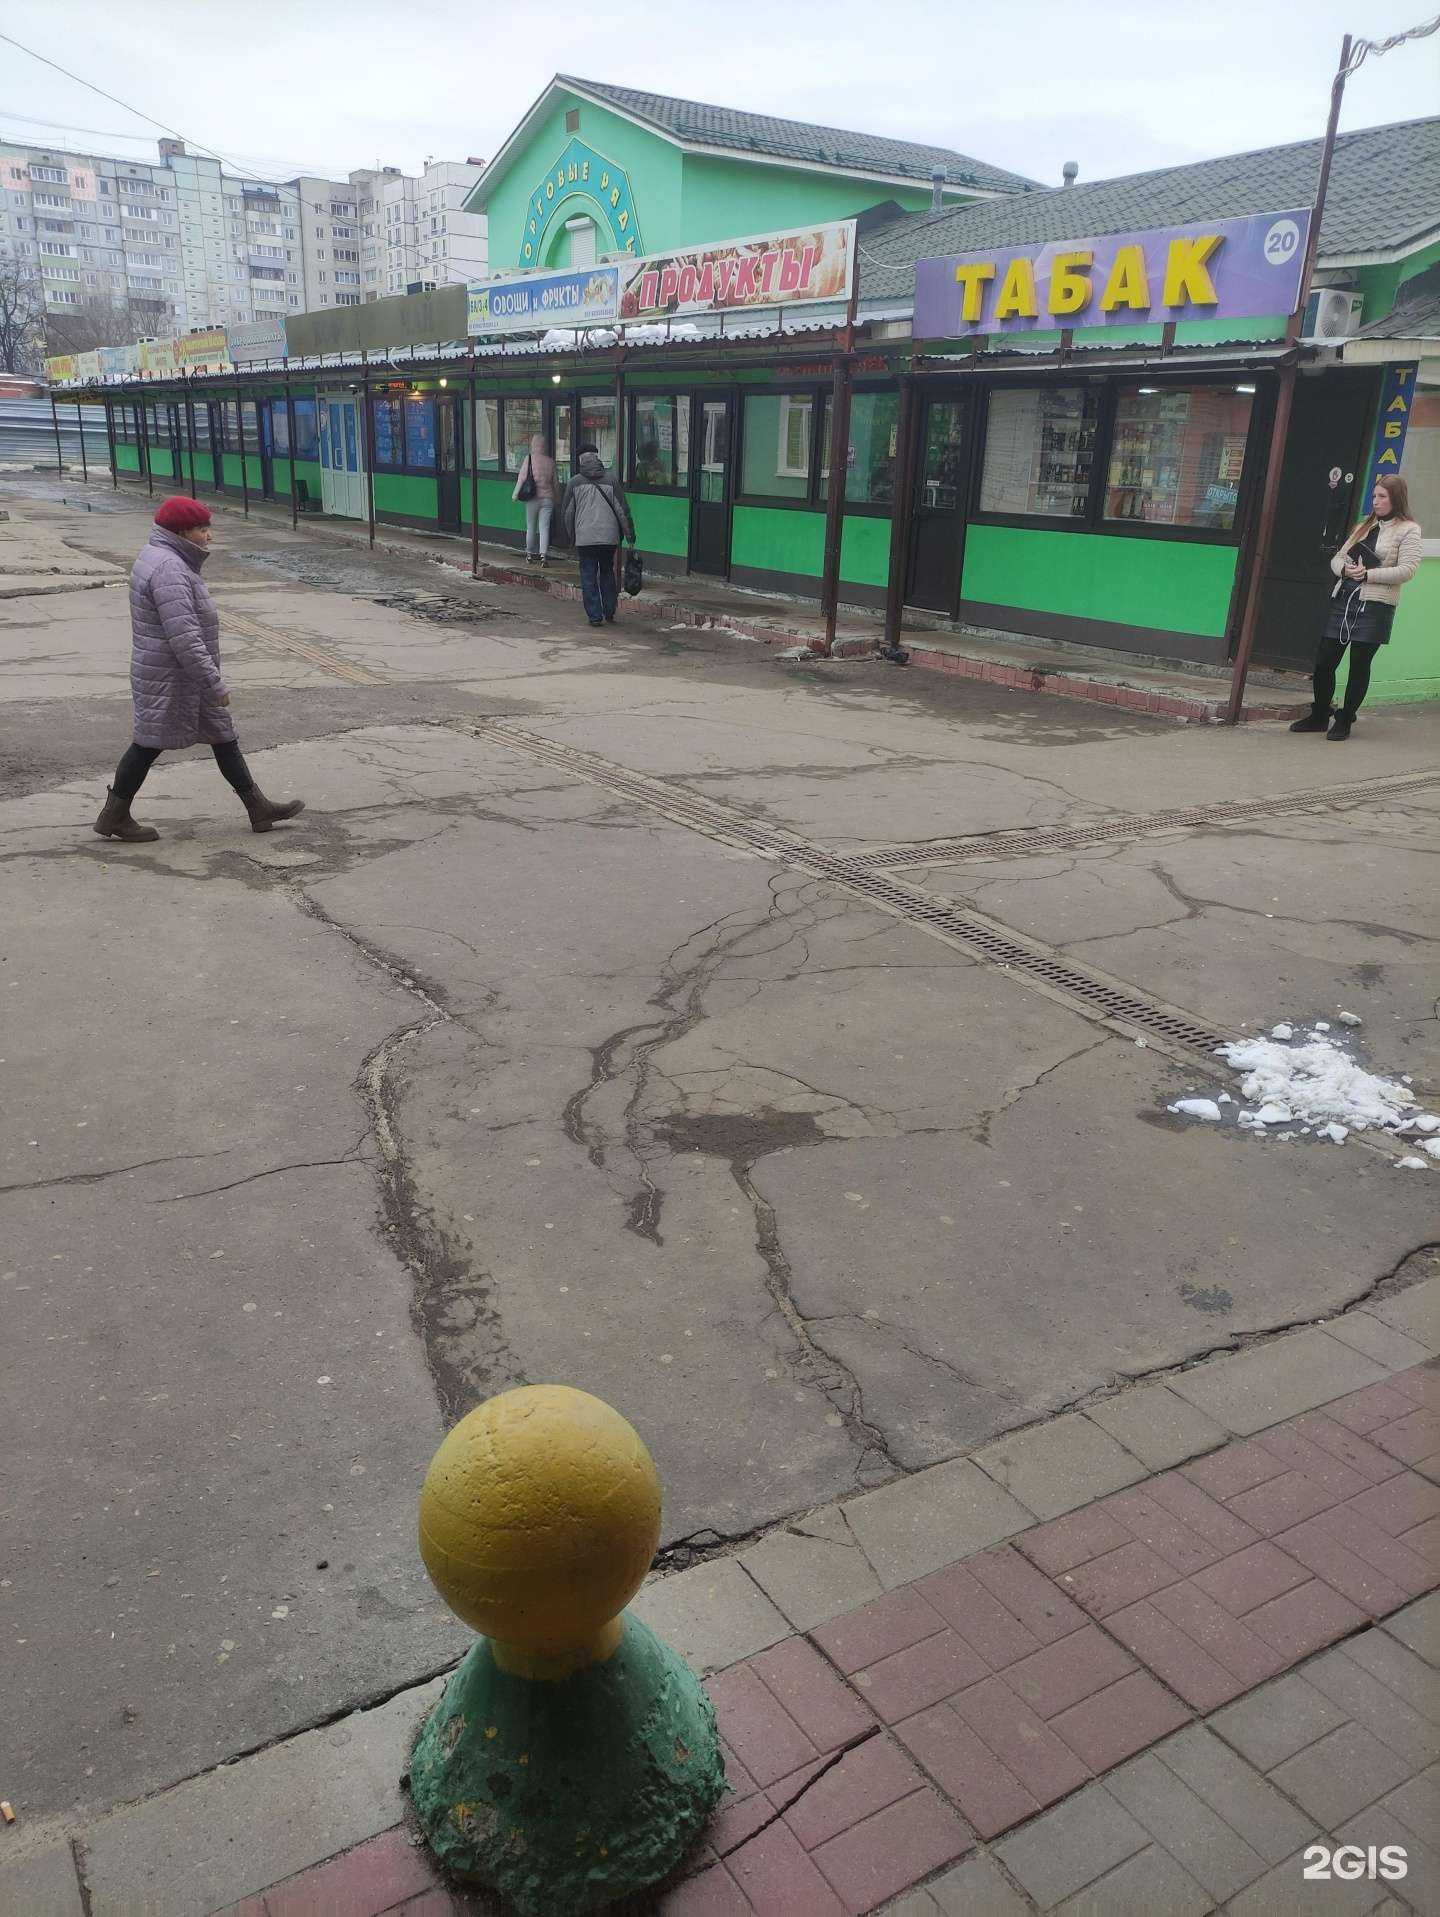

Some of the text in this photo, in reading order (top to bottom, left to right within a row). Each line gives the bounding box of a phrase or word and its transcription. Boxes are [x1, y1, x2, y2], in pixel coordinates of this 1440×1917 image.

[525, 161, 590, 259] ОРГОВЫЕ
[1268, 231, 1297, 254] 20
[493, 290, 529, 315] ОВОЩИ
[541, 284, 580, 307] ФРУКТЫ
[638, 245, 816, 311] ПРОДУКТЫ
[954, 234, 1227, 323] ТАБАК
[1376, 367, 1414, 481] ТАБА
